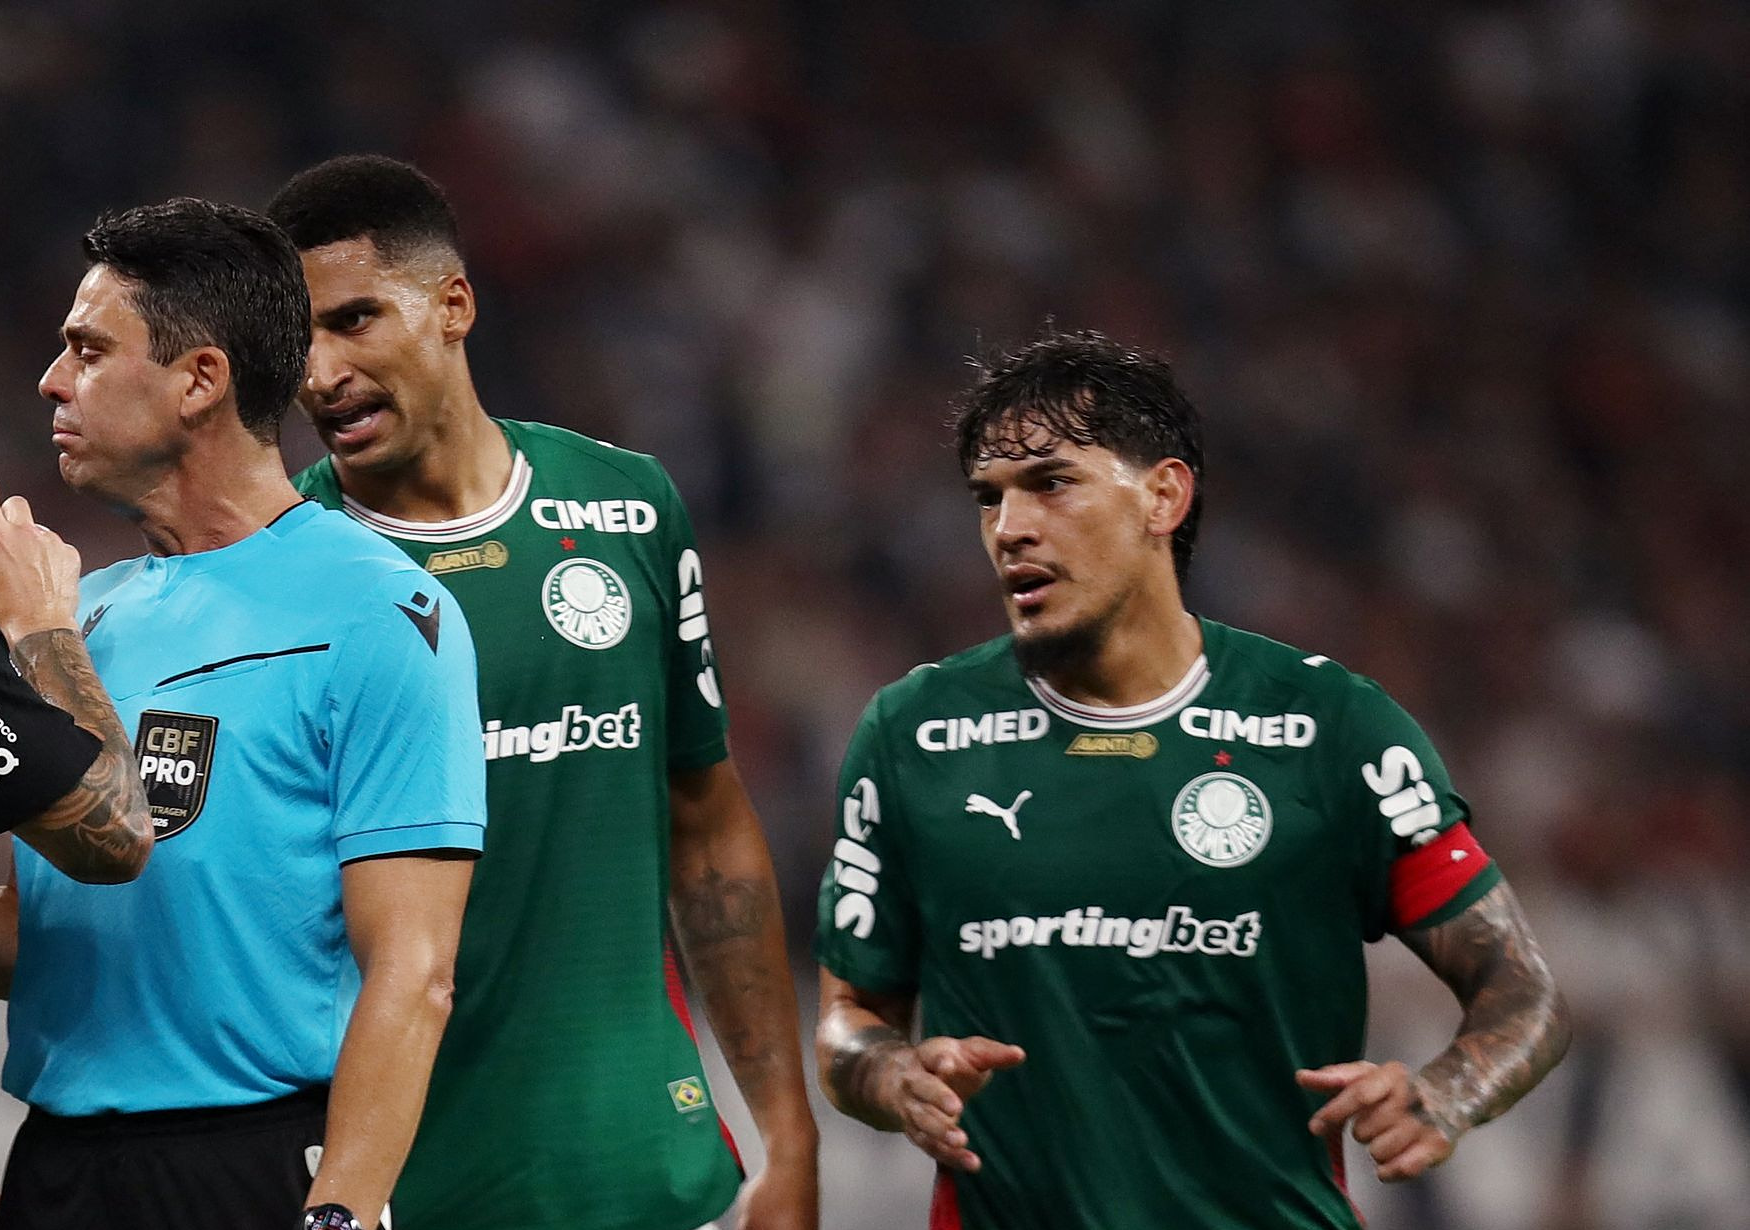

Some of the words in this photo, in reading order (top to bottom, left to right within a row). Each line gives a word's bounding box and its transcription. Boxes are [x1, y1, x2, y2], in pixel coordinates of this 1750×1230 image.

[530, 498, 658, 534] CIMED
[146, 726, 202, 755] CBF
[481, 702, 641, 763] ingbet
[916, 708, 1050, 752] CIMED
[1179, 706, 1317, 748] CIMED
[959, 905, 1263, 960] sportingbet
